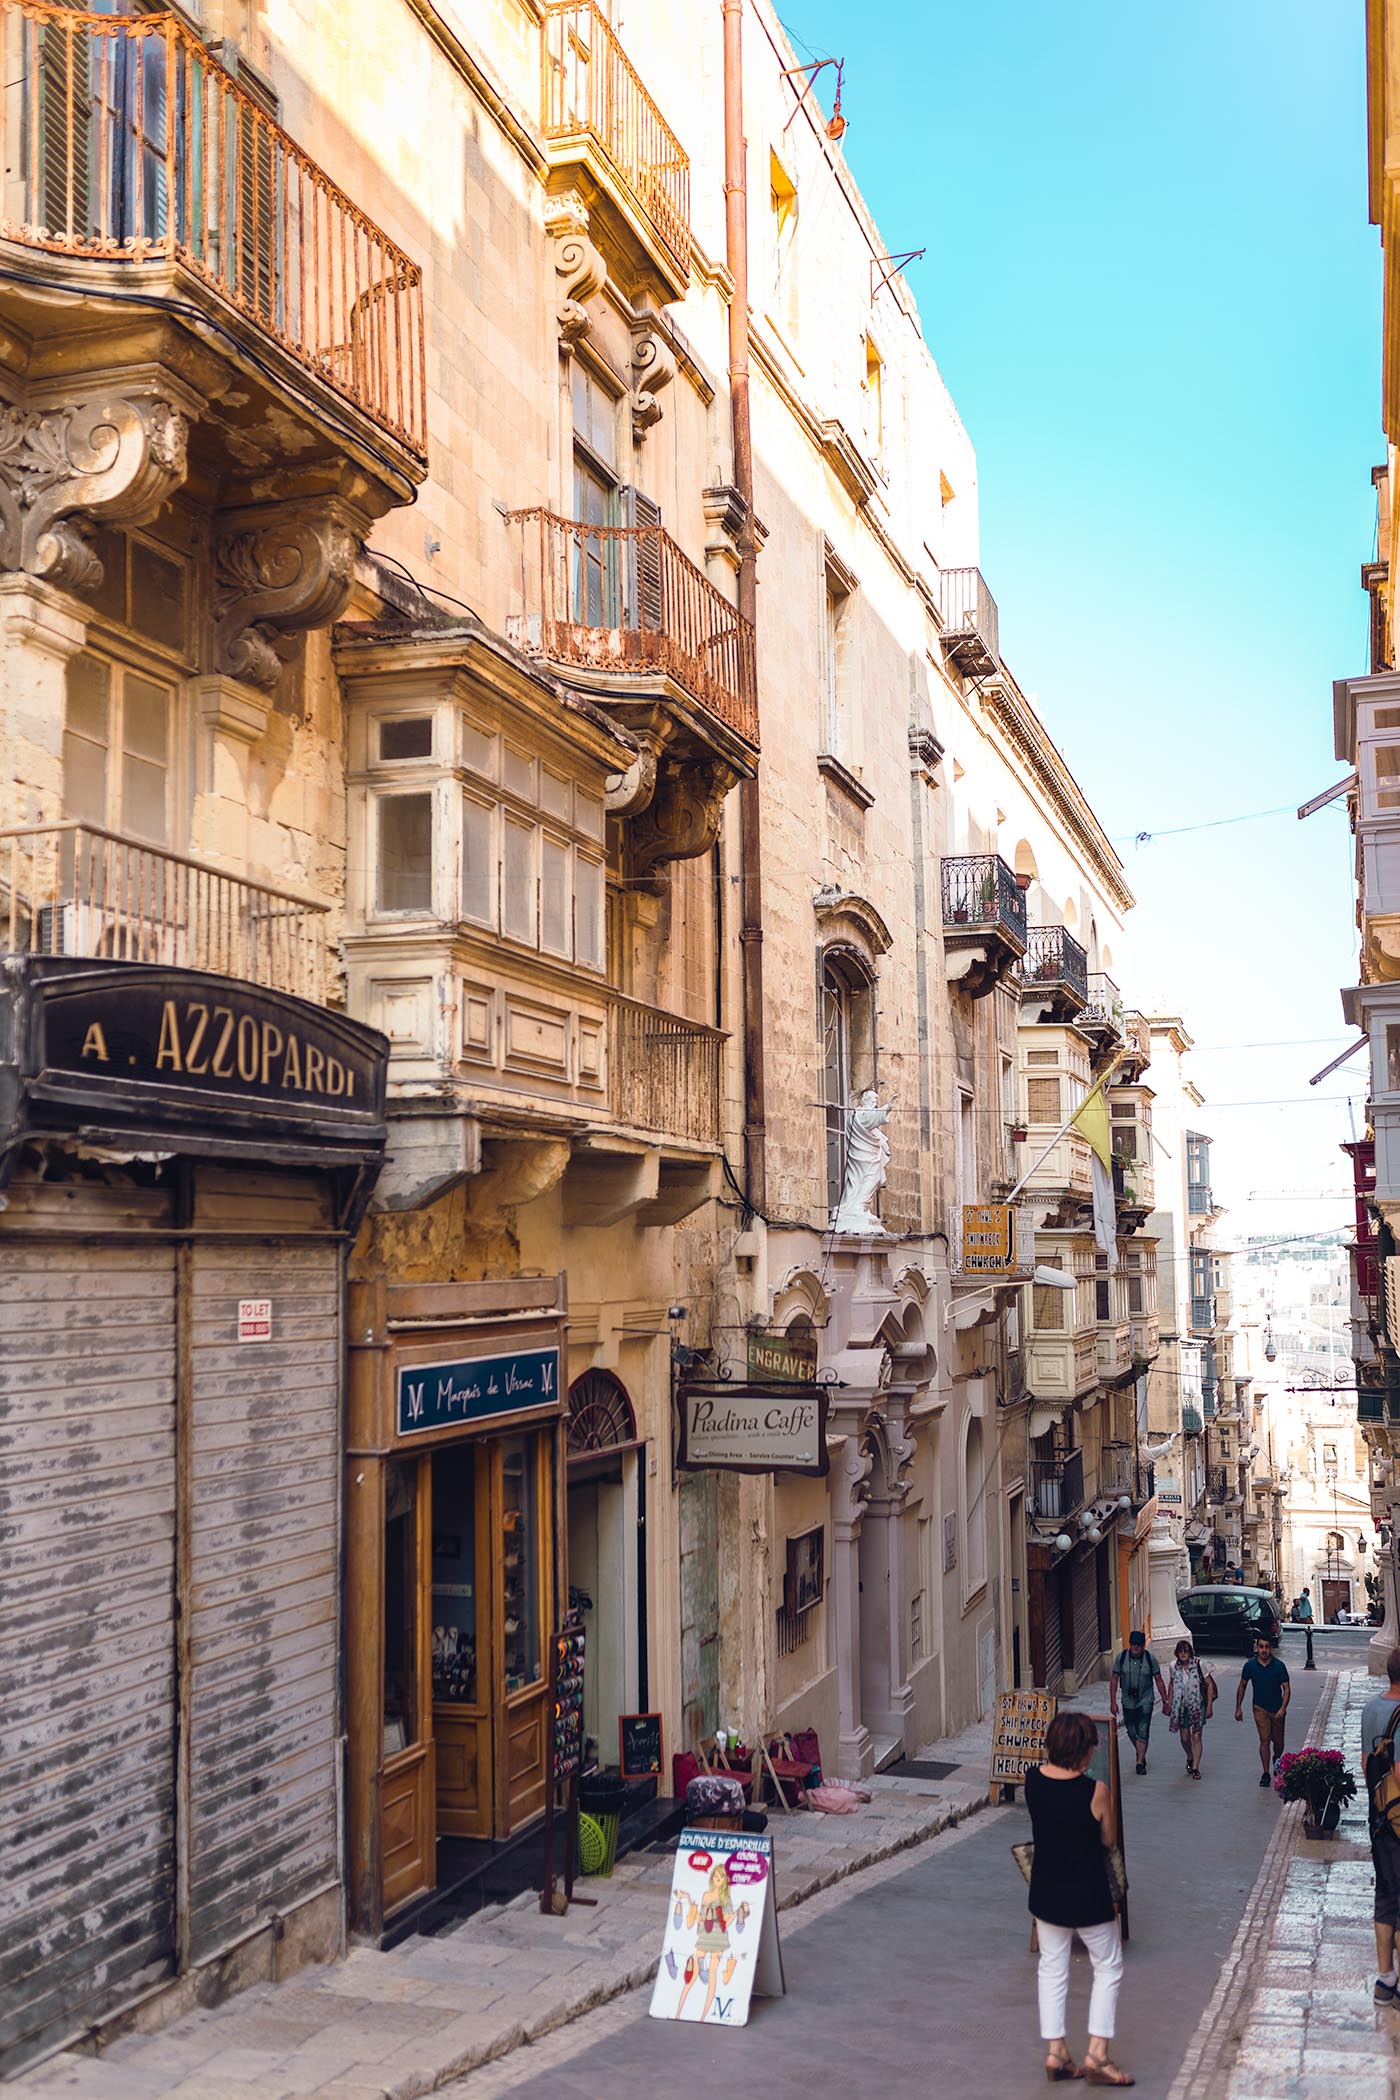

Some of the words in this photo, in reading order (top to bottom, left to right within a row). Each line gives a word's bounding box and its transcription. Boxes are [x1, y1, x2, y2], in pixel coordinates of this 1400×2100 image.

[155, 1000, 354, 1097] AZZOPARDI
[965, 1255, 1002, 1268] CHURCH
[241, 1304, 252, 1317] TO
[254, 1303, 269, 1316] LET
[749, 1346, 815, 1381] ENGRAVER
[436, 1377, 481, 1413] Marquis
[487, 1374, 499, 1395] de
[505, 1363, 534, 1395] Vissac
[691, 1401, 758, 1433] Piadina
[764, 1406, 814, 1436] Caffe
[1002, 1698, 1012, 1709] ST
[1017, 1699, 1048, 1712] PAUL'S
[998, 1735, 1047, 1749] CHURCH
[680, 1834, 715, 1849] BOUTIQUE
[692, 1856, 708, 1866] NEW
